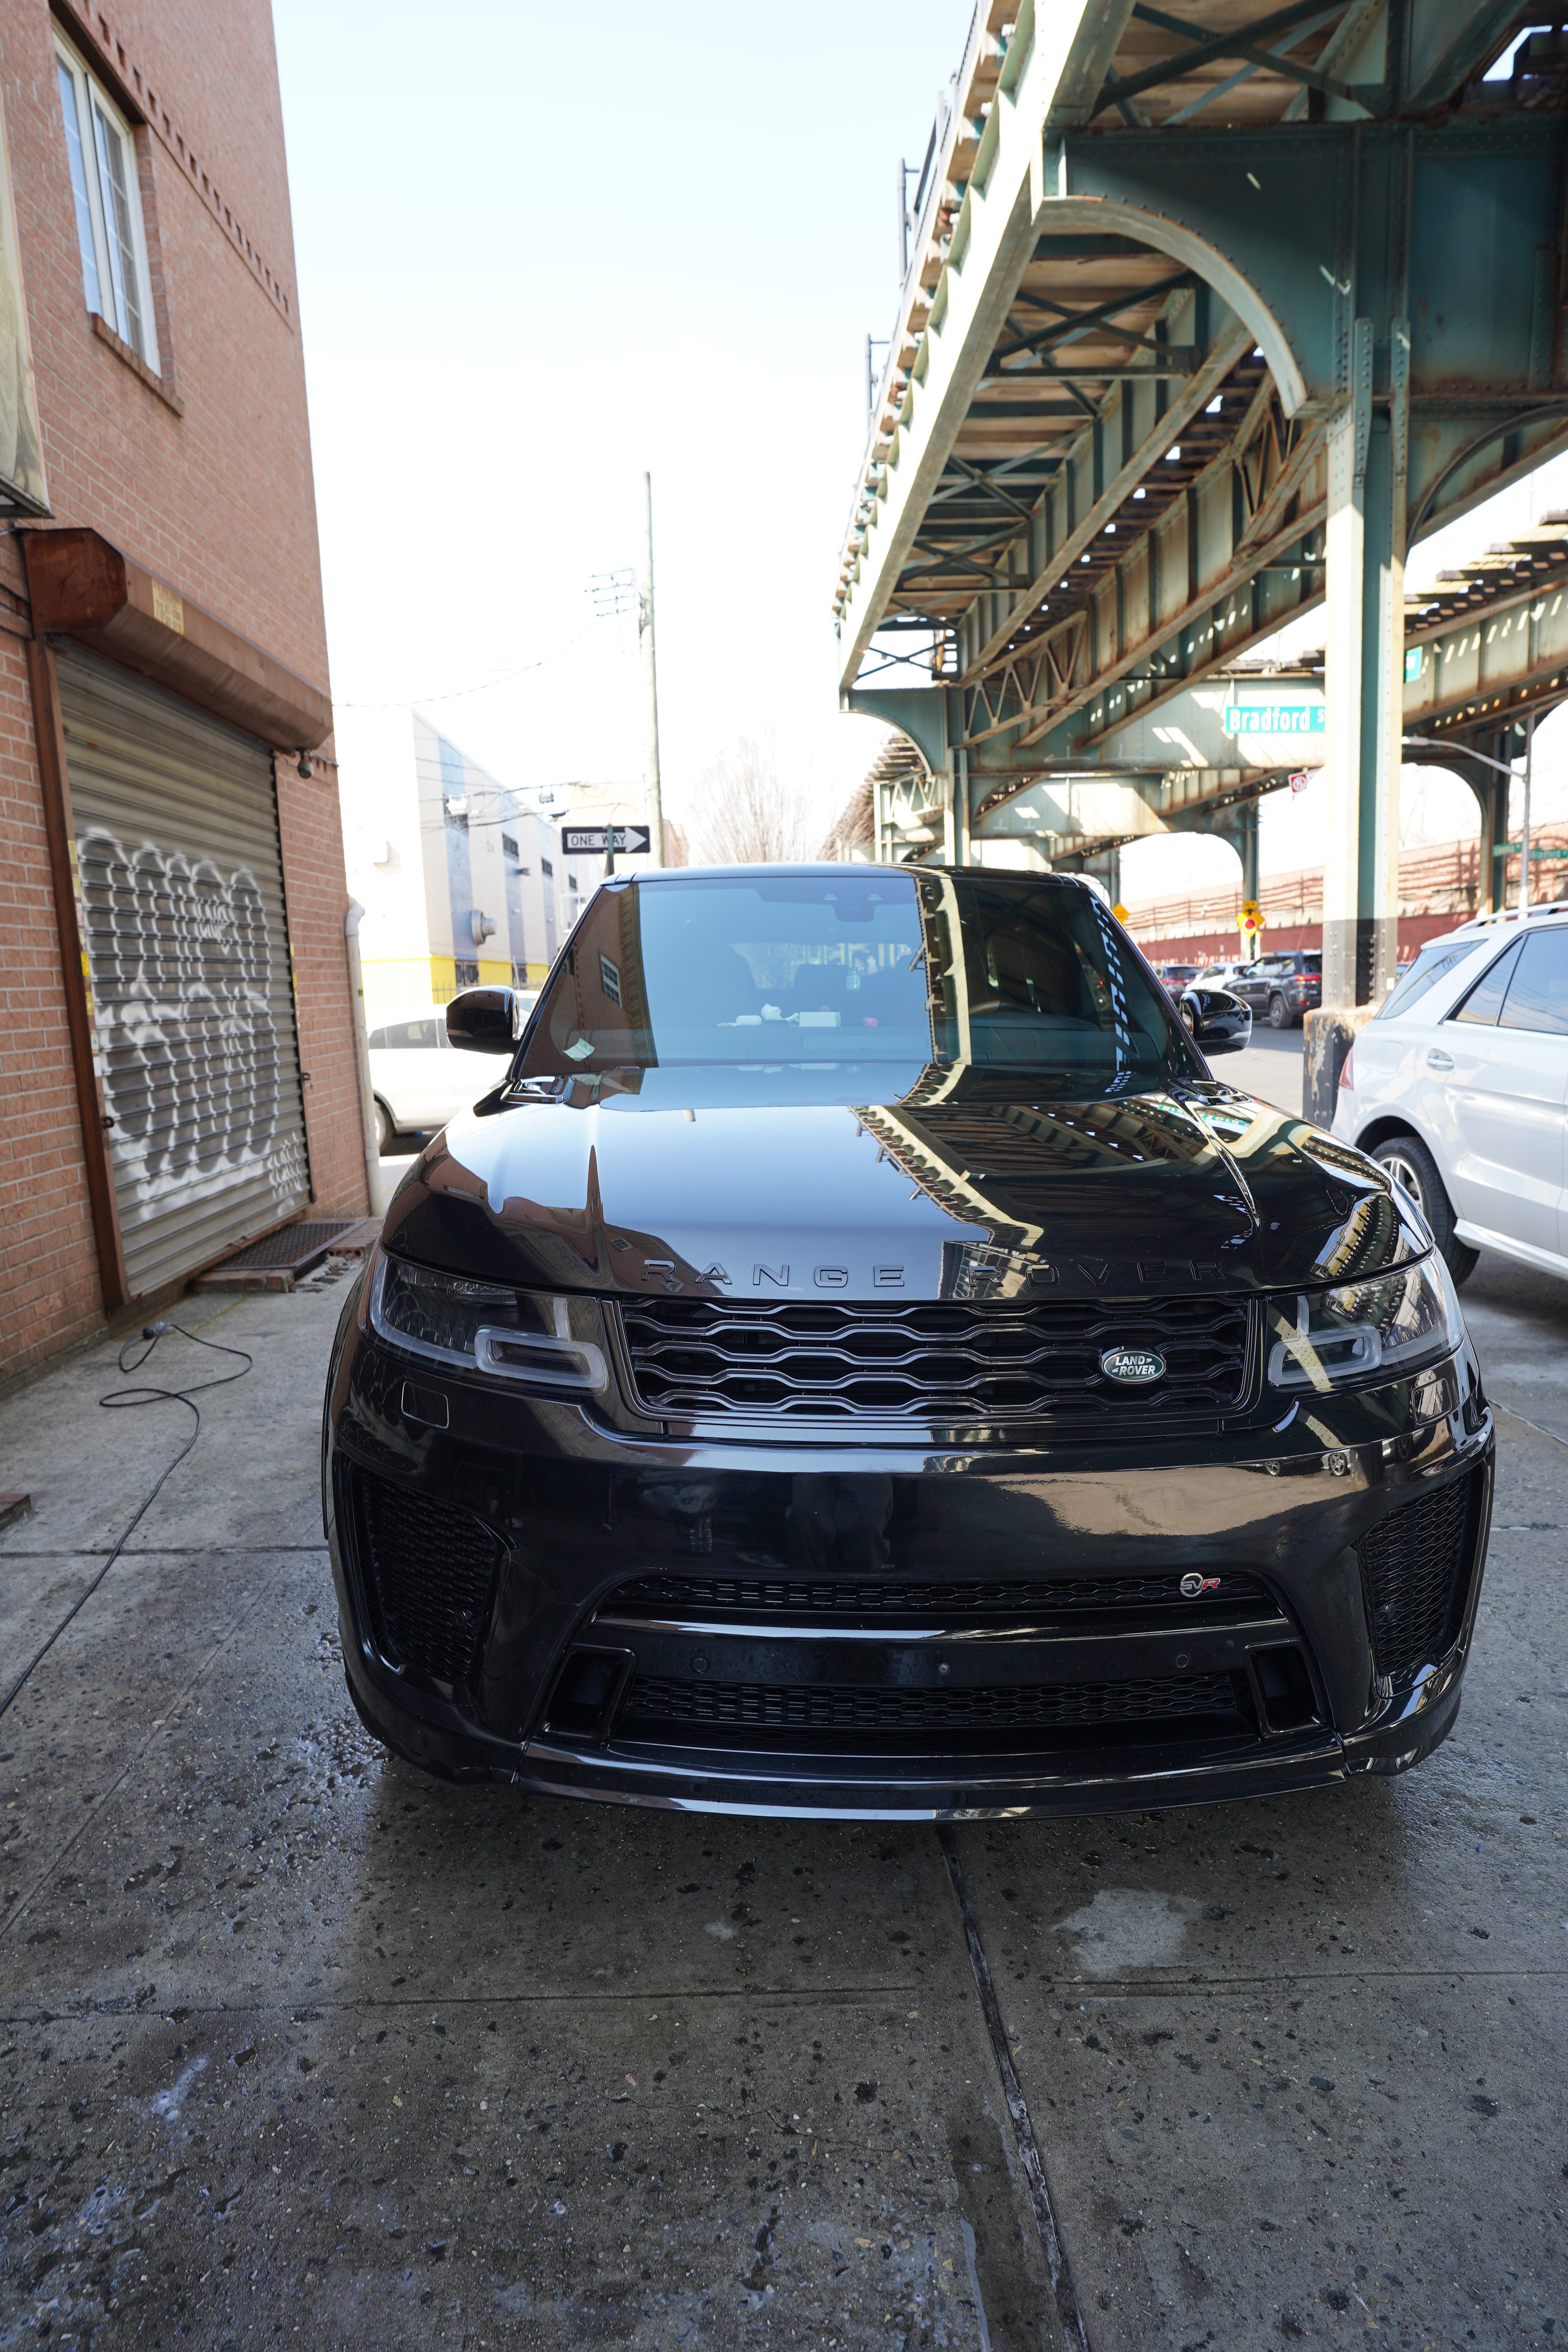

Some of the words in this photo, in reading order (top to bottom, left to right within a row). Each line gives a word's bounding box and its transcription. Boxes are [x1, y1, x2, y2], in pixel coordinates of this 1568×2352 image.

[1230, 707, 1310, 731] Bradford
[1317, 708, 1324, 723] S
[572, 835, 595, 846] ONE
[641, 1259, 904, 1288] RANGE
[968, 1259, 1225, 1288] ROVER
[1115, 1356, 1145, 1366] LAND
[1119, 1365, 1156, 1376] ROVER
[1180, 1575, 1220, 1594] SVR
